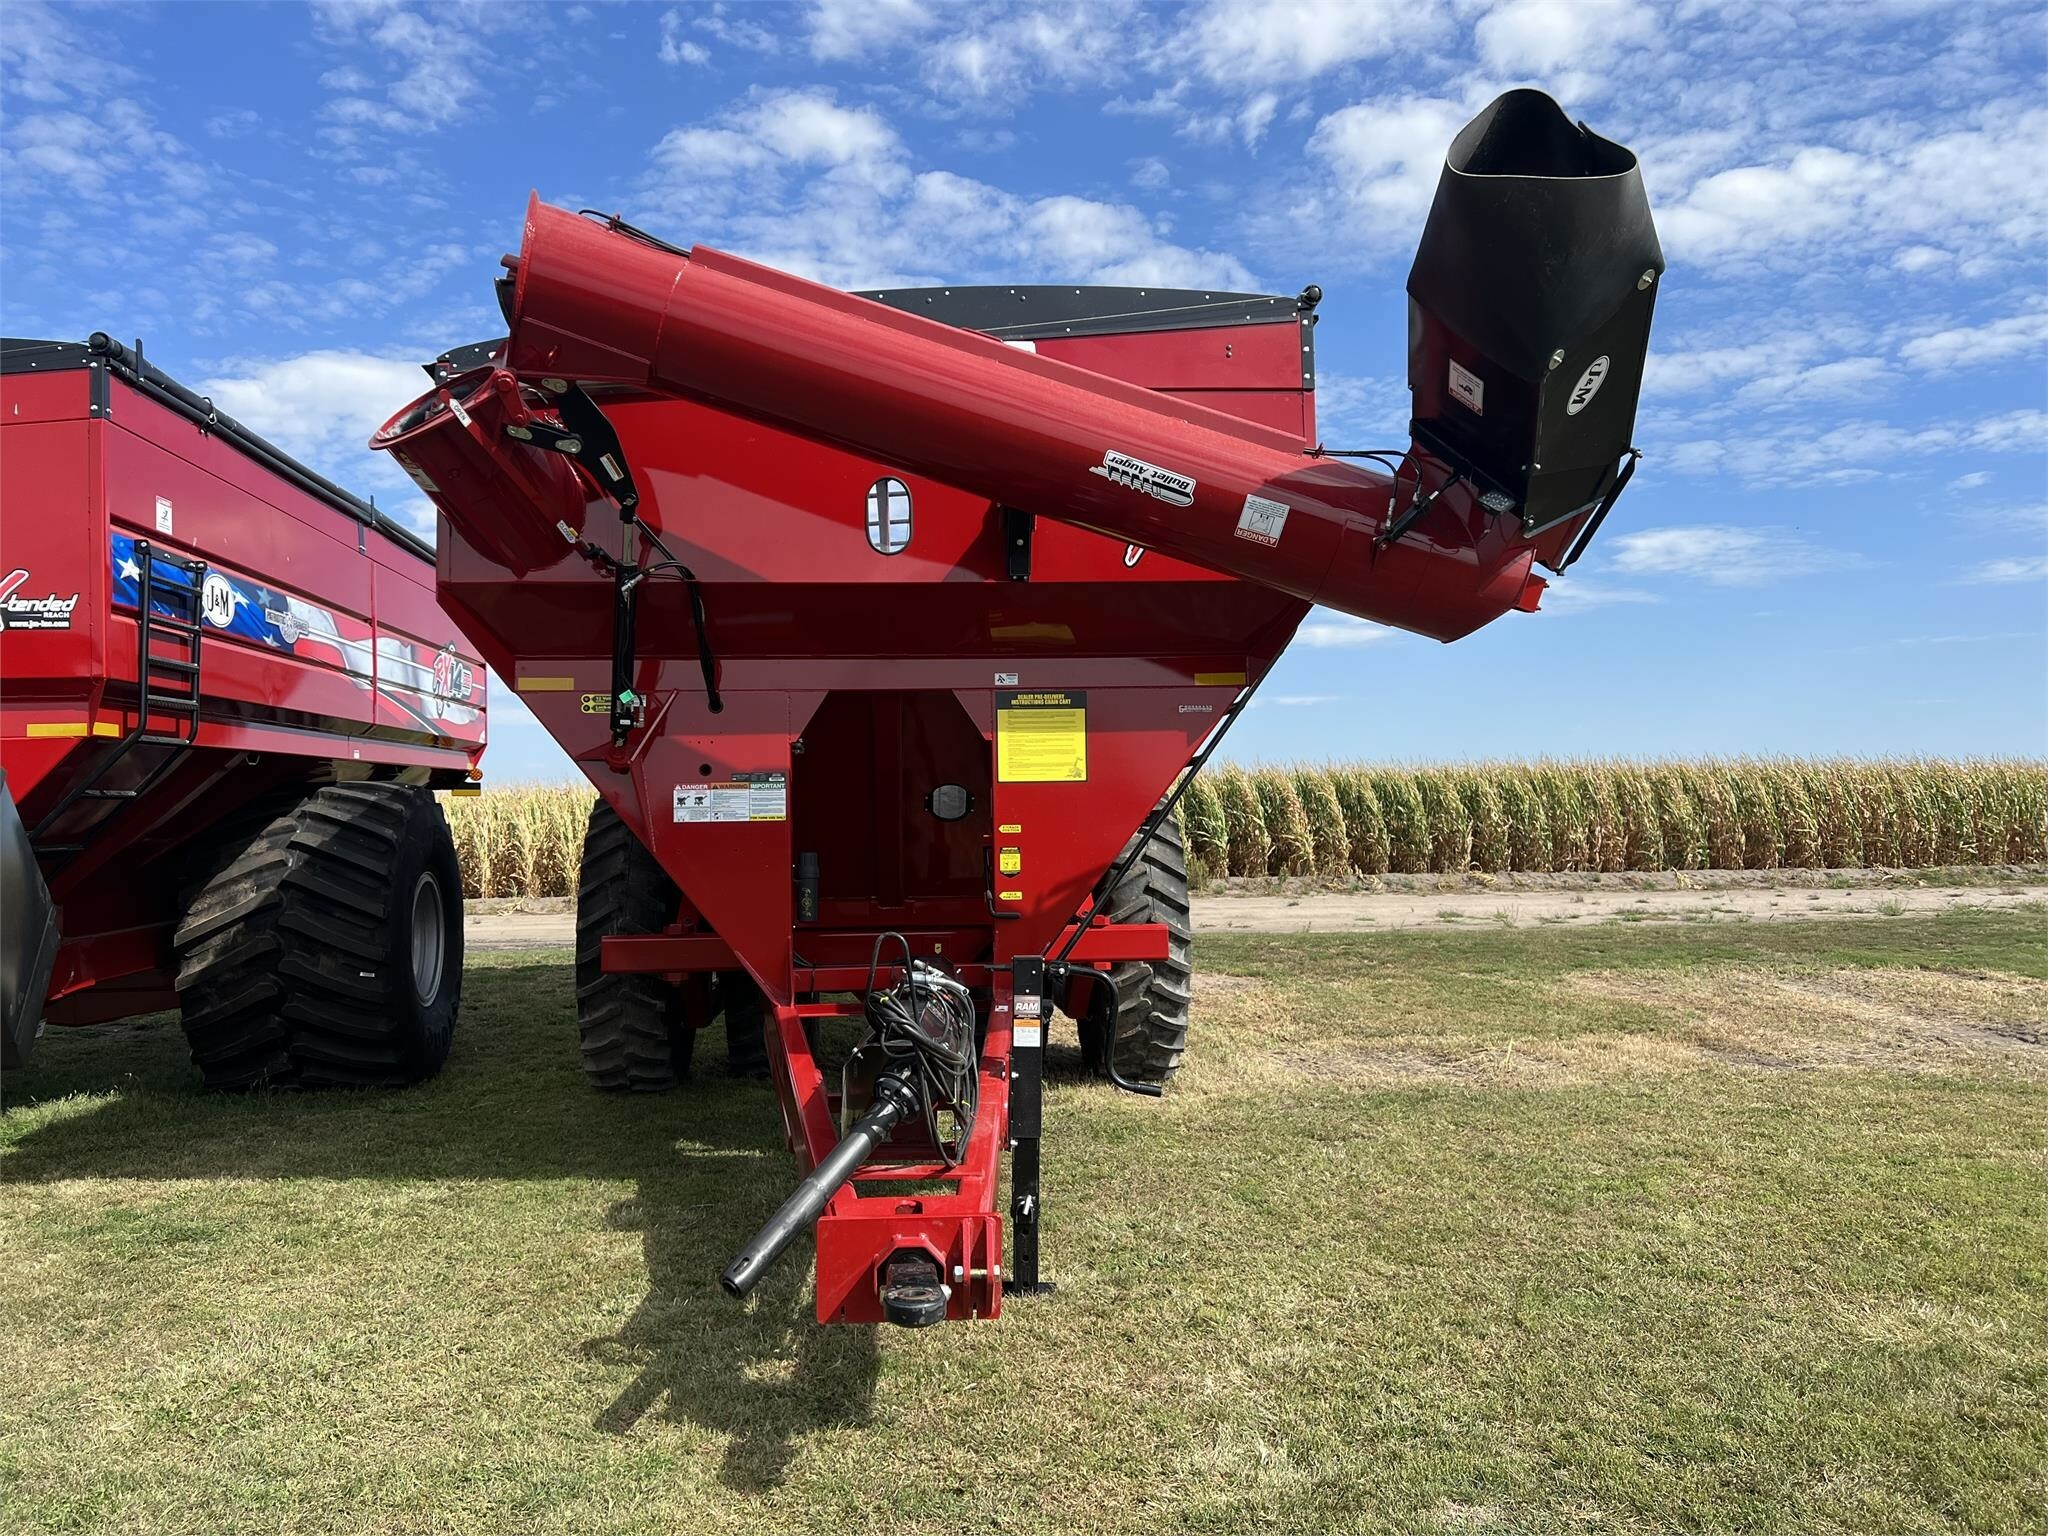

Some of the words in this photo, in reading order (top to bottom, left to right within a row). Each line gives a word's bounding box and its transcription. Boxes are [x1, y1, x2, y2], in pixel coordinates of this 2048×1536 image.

[1571, 362, 1603, 405] J&M
[1108, 456, 1150, 475] Auger
[1150, 470, 1190, 490] Bullet
[1236, 528, 1270, 543] DANGER
[206, 584, 230, 618] J&M
[1015, 1002, 1039, 1010] RAM
